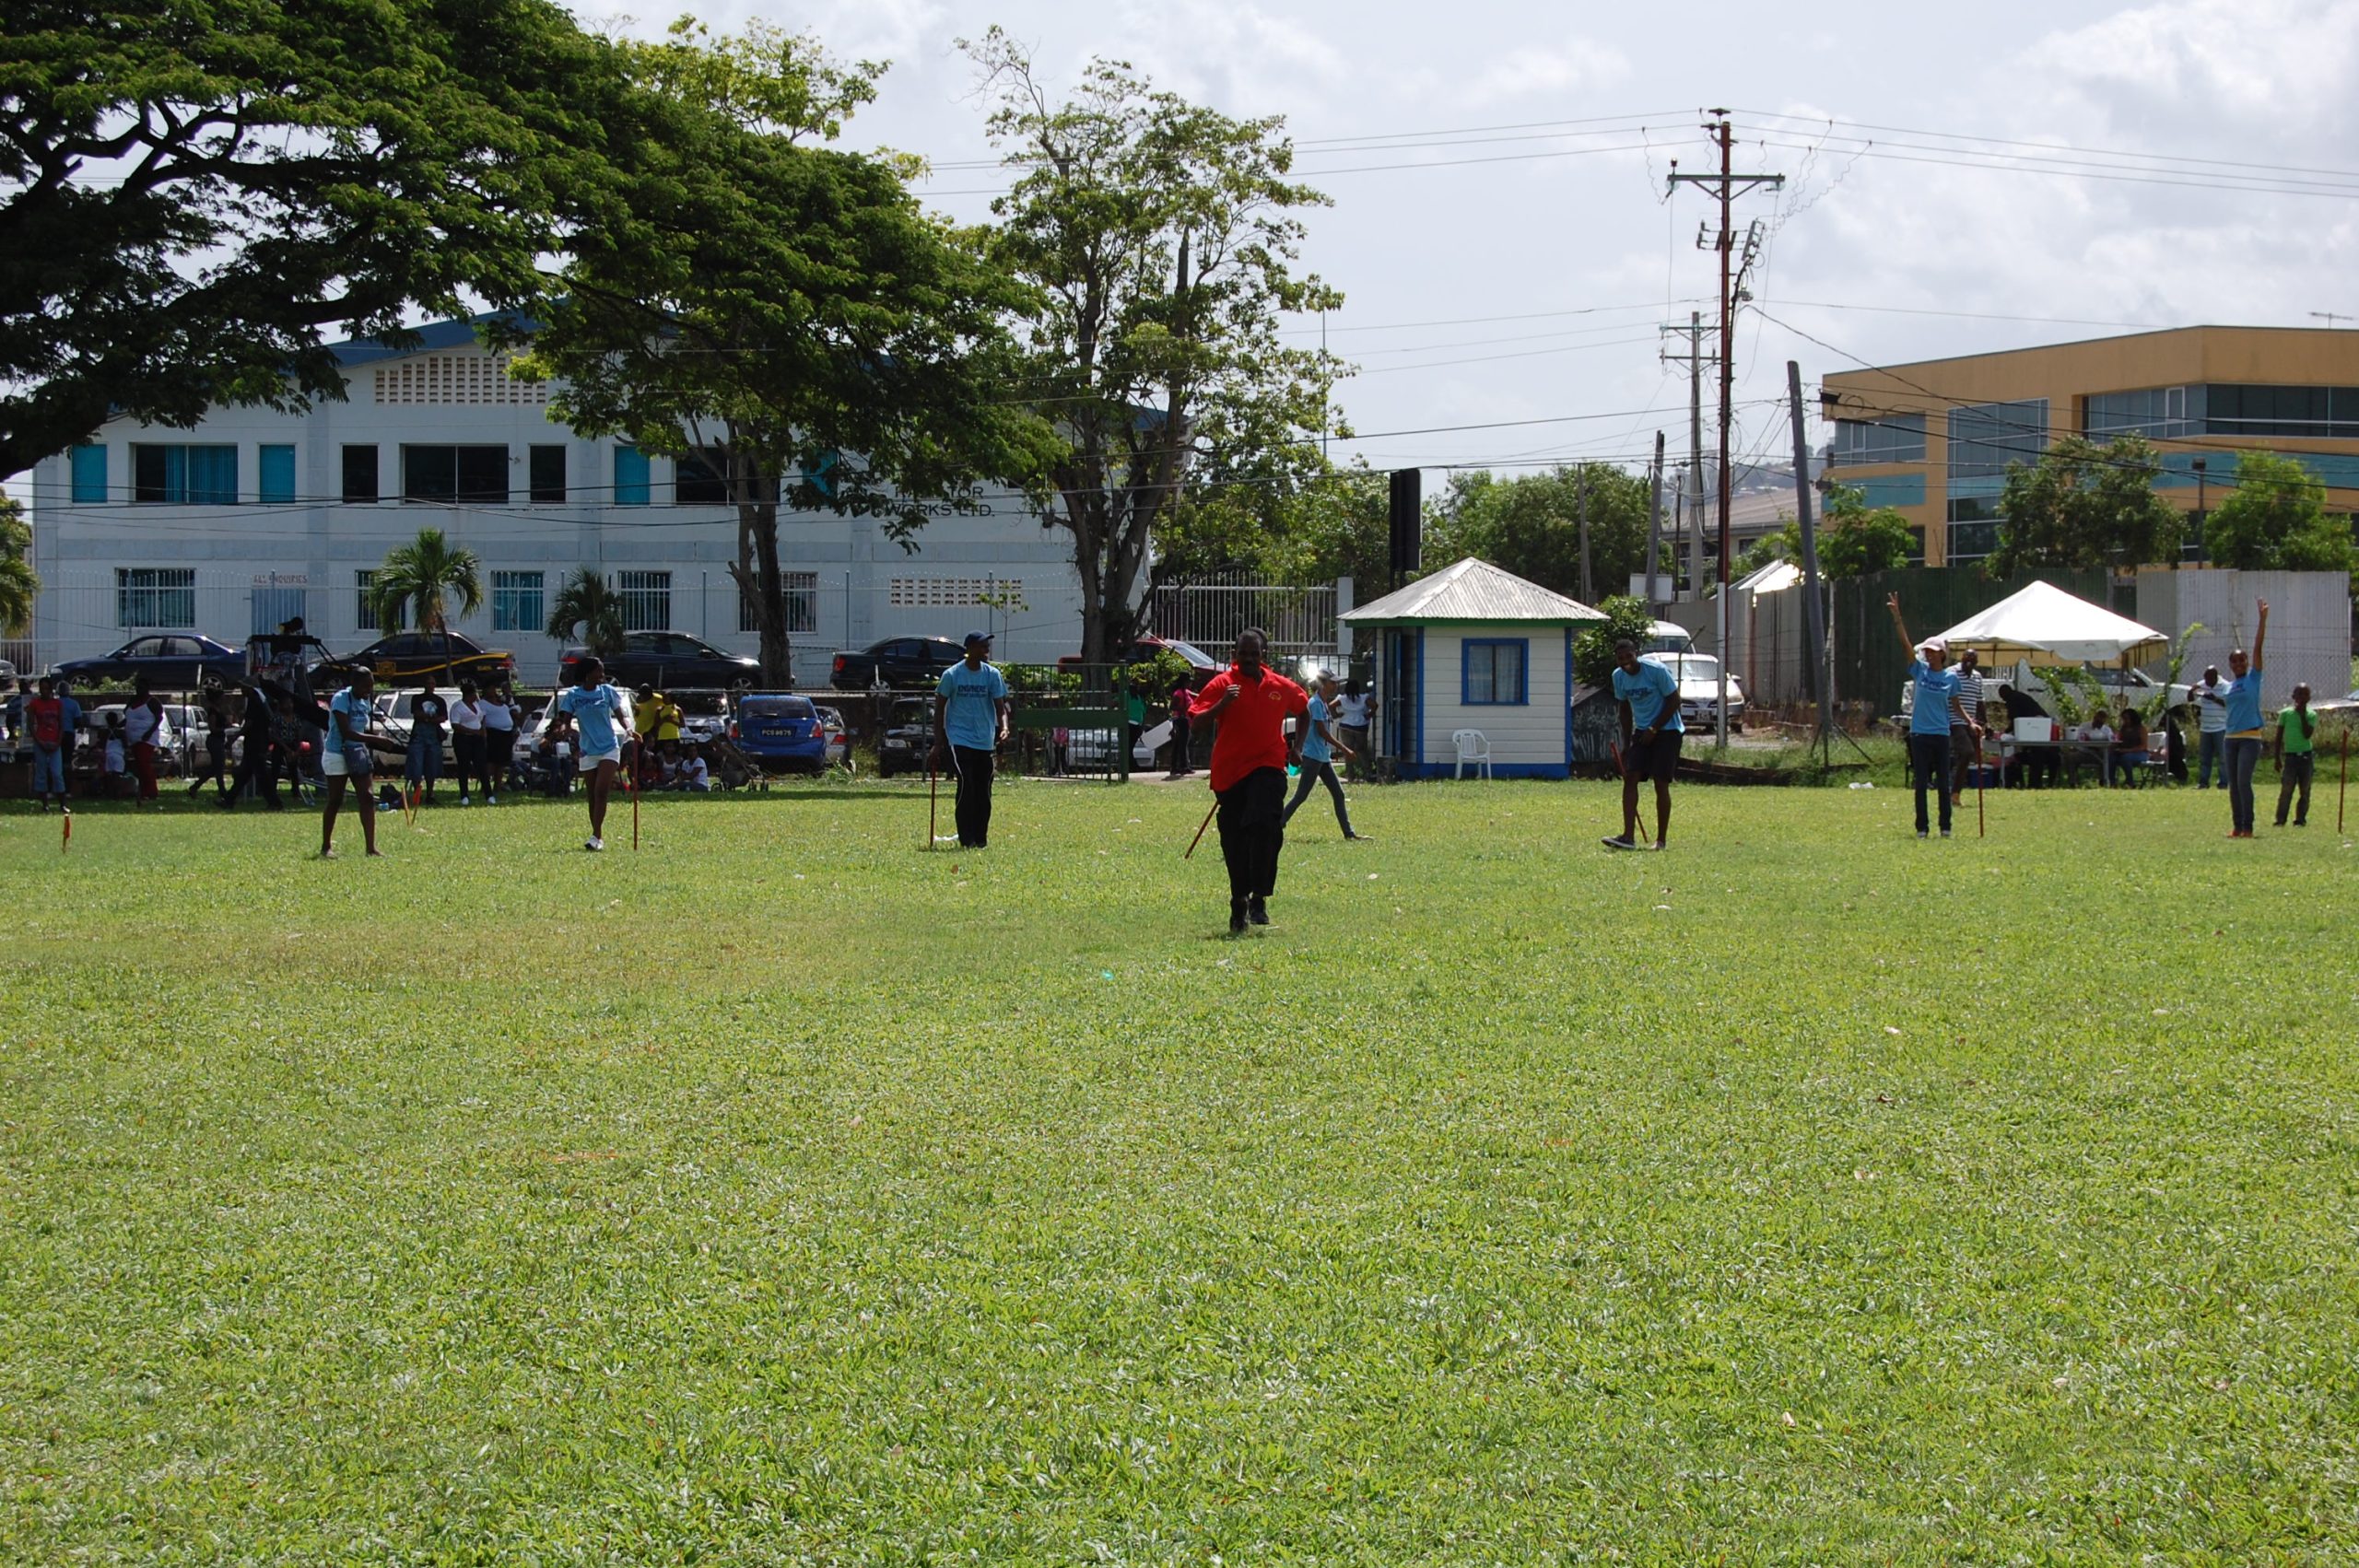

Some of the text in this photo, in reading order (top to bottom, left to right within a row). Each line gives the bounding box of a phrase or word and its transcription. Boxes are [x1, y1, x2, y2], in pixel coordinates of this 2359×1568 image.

[886, 504, 995, 517] WORKS LTD.
[253, 575, 308, 584] ALL ENQUIRIES
